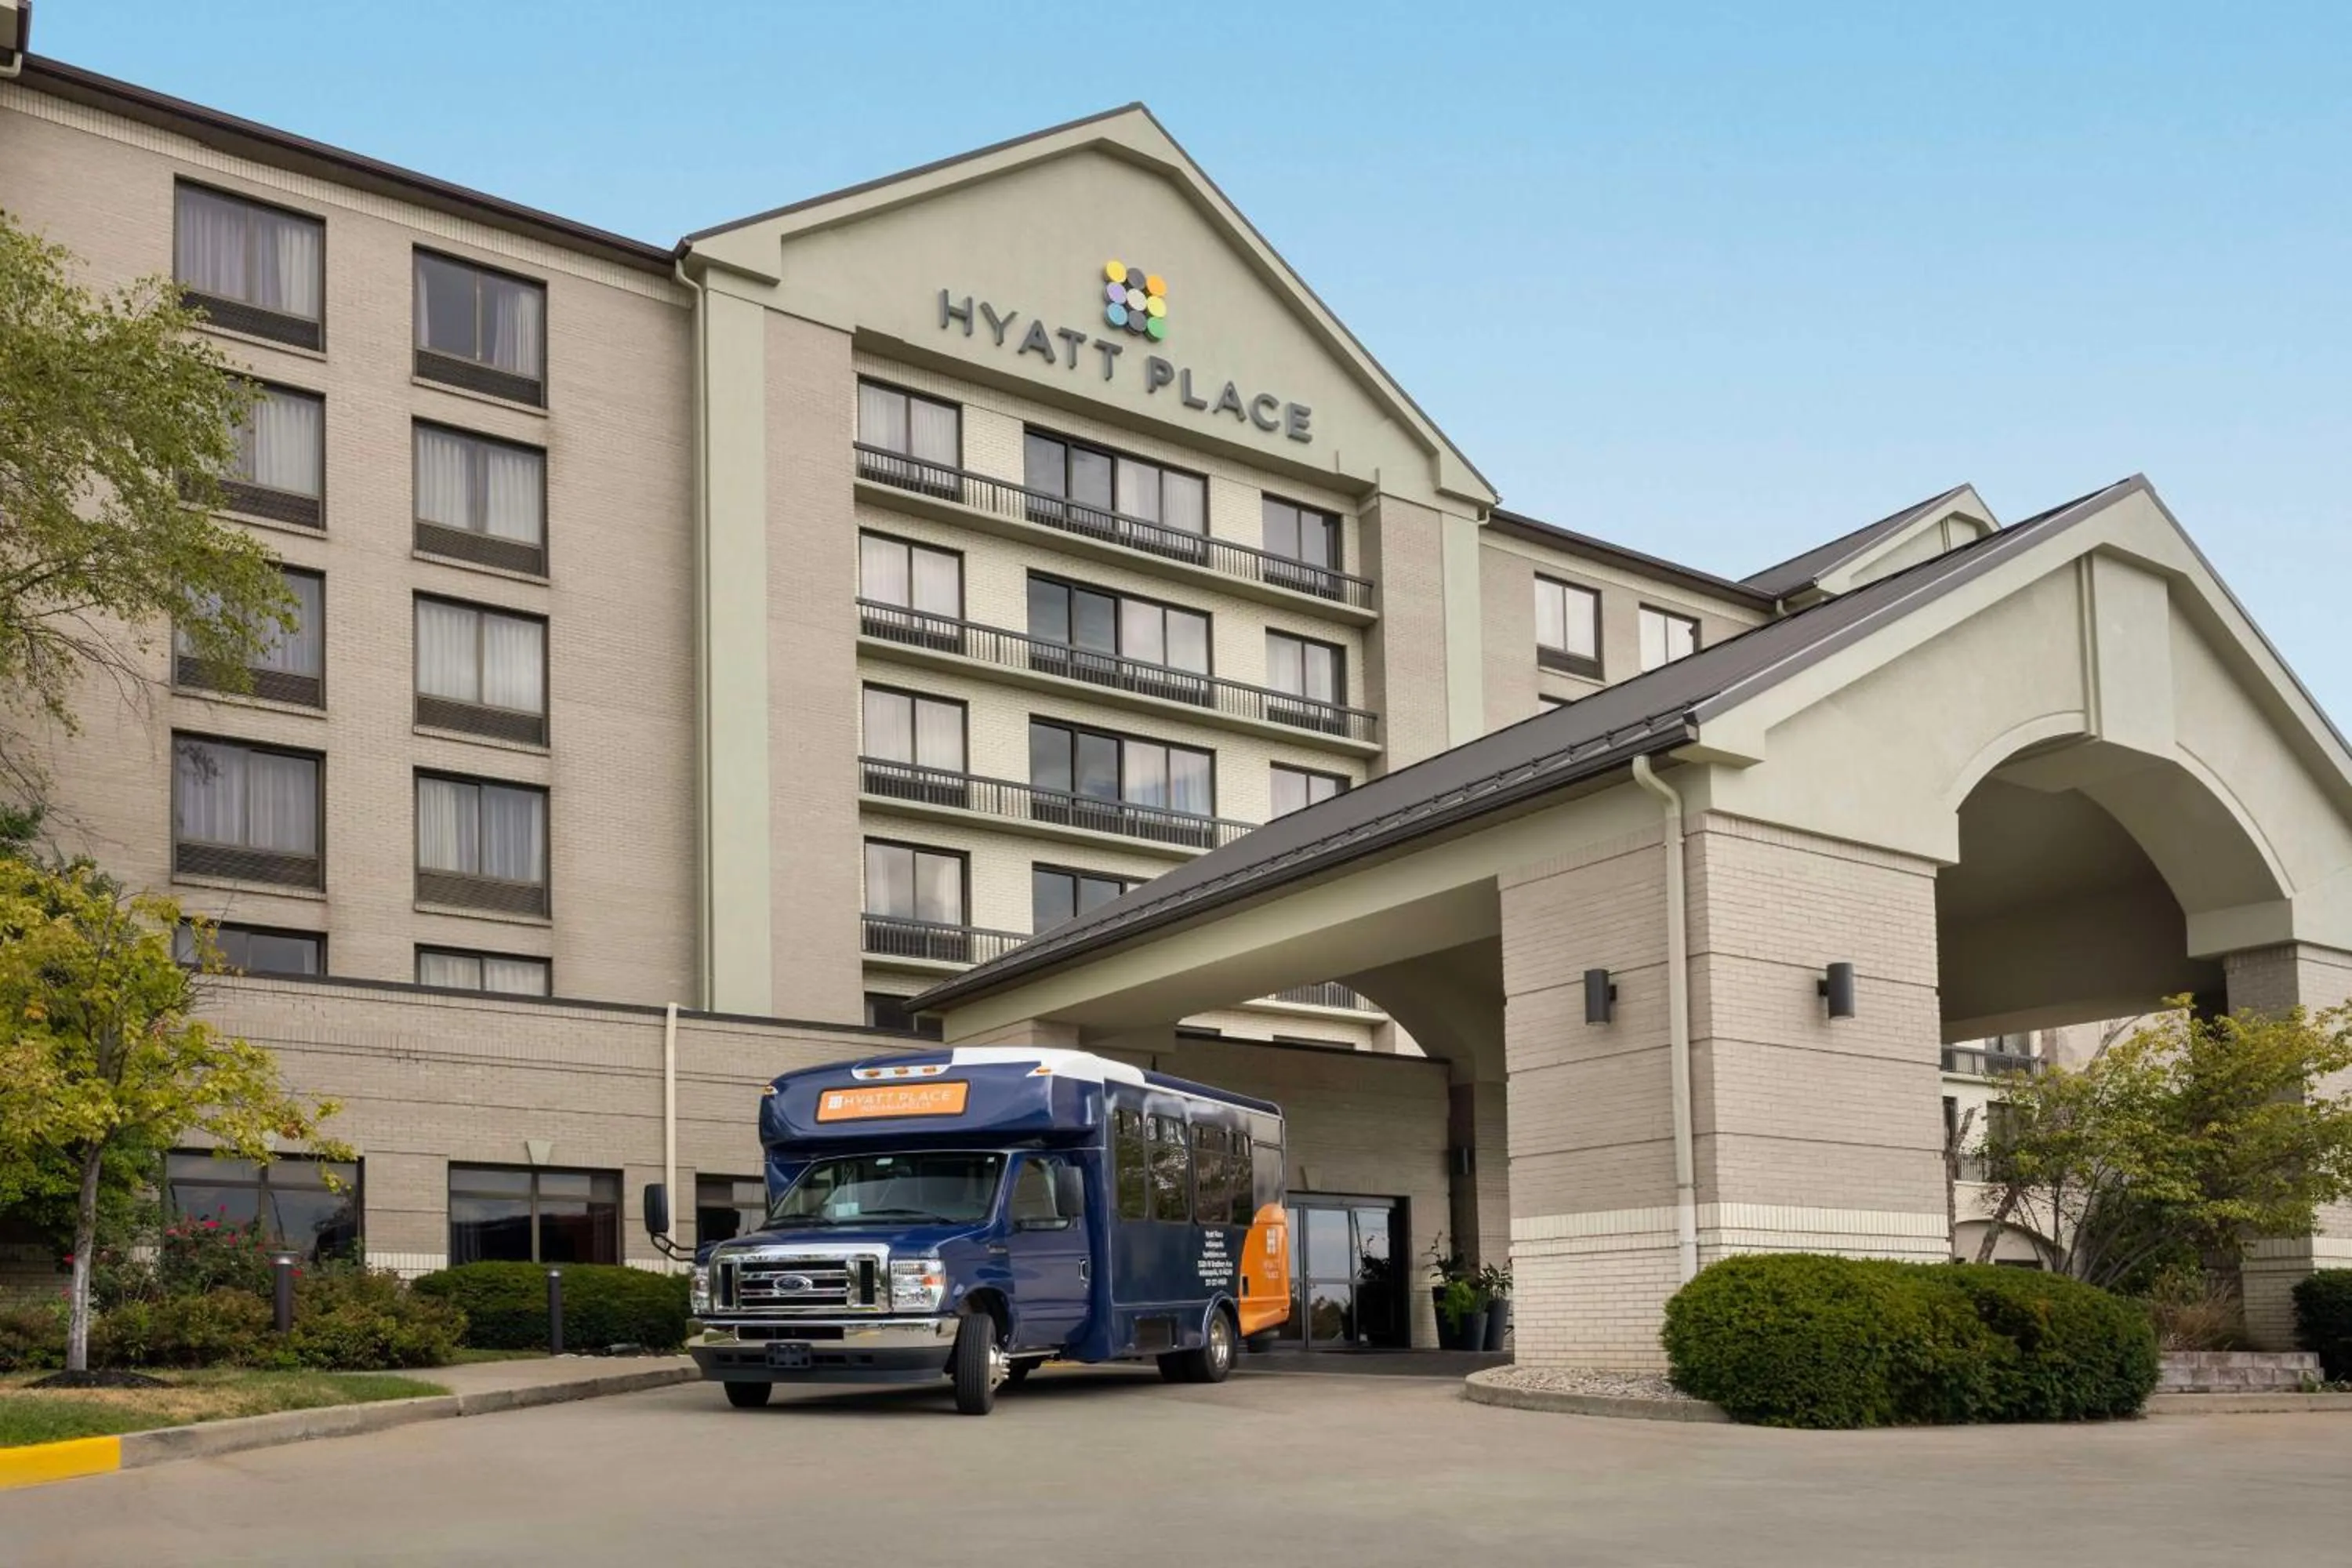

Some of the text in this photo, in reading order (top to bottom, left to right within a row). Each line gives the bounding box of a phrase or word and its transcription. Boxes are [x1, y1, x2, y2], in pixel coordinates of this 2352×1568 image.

[938, 288, 1312, 444] HYATT PLACE
[843, 1090, 952, 1105] HYATT PLACE
